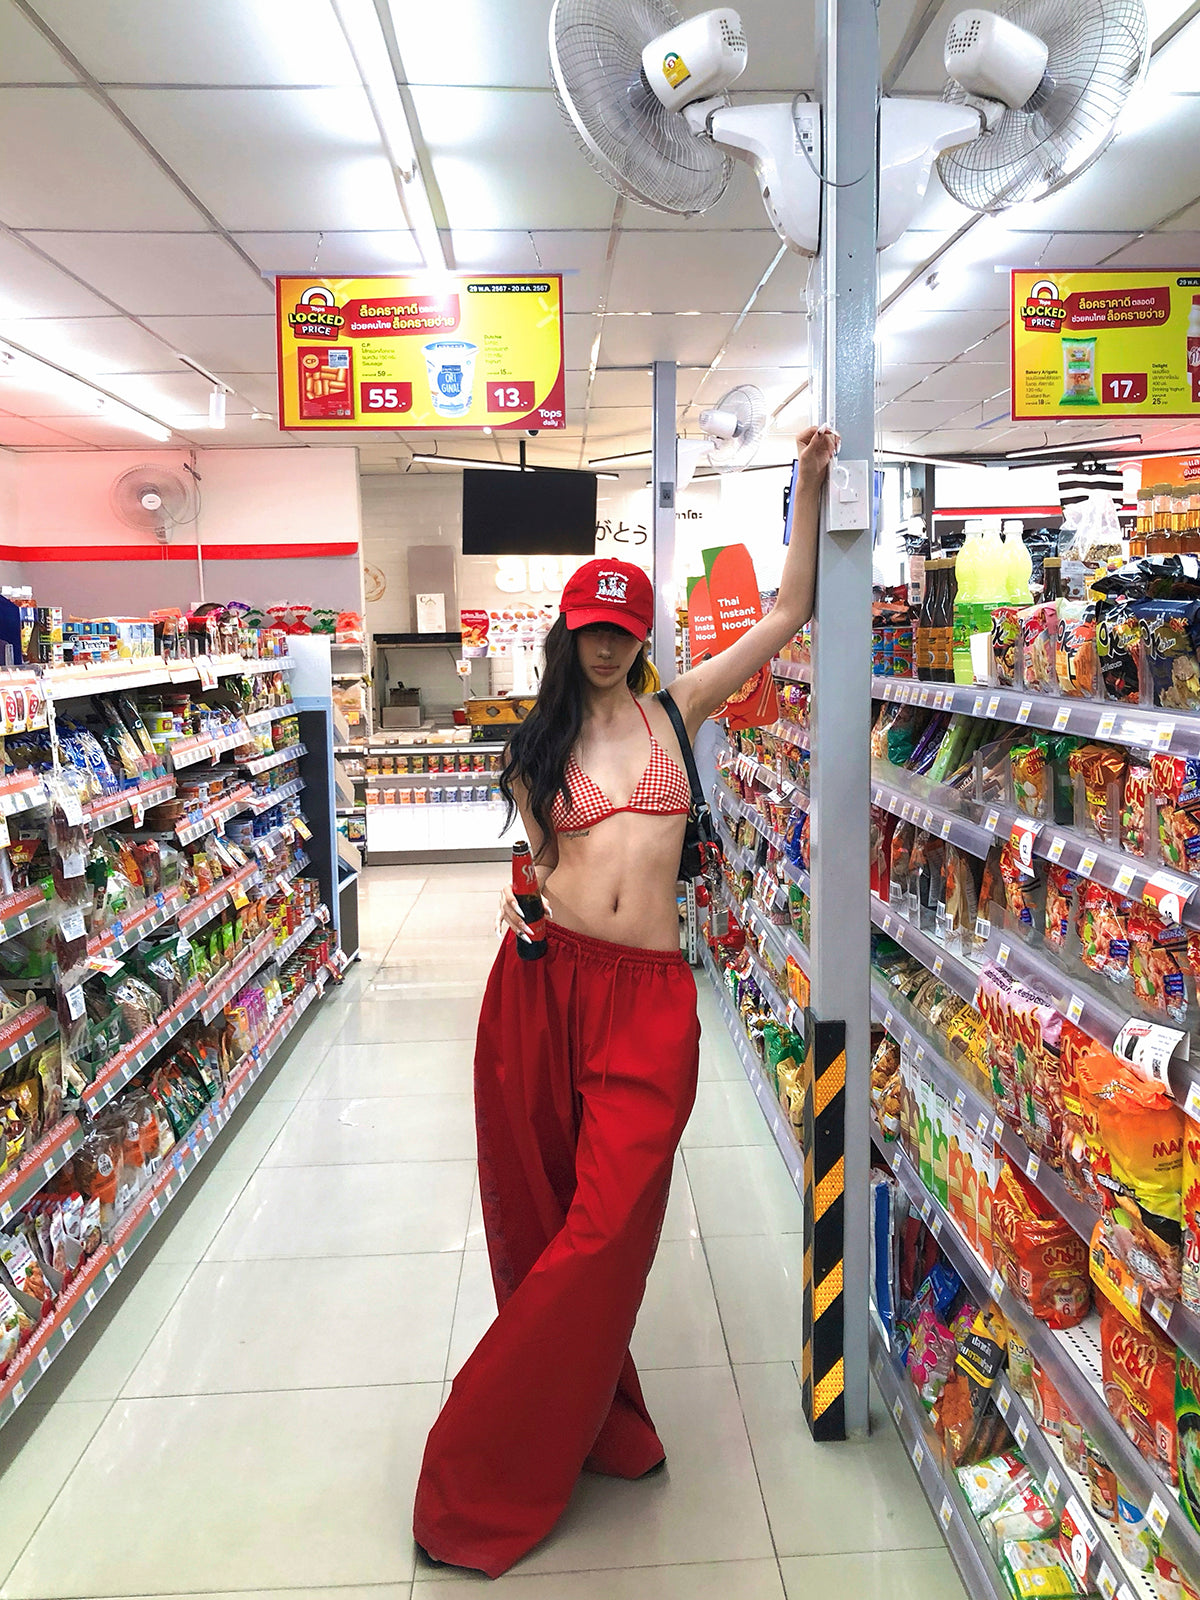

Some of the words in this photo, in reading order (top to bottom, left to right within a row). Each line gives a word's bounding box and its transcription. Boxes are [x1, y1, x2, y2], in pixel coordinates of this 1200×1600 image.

[1078, 296, 1131, 310] ล็อคราคาดี
[360, 303, 418, 318] ล็อคราคาดี
[1021, 306, 1067, 319] LOCKED
[1071, 312, 1106, 323] ช่วยคนไทย
[1107, 308, 1165, 322] ล็อครายจ่าย
[289, 312, 344, 327] LOCKED
[1031, 317, 1056, 328] PRICE
[302, 325, 331, 336] PRICE
[538, 409, 562, 419] Tops
[717, 596, 739, 608] Thai
[694, 615, 713, 623] Kore
[719, 606, 756, 620] Instant
[694, 624, 715, 632] Insta
[695, 632, 717, 641] Nood
[1152, 1138, 1184, 1158] MA
[1021, 1275, 1028, 1288] 6
[1062, 1303, 1071, 1316] 6
[1159, 1434, 1167, 1450] 6
